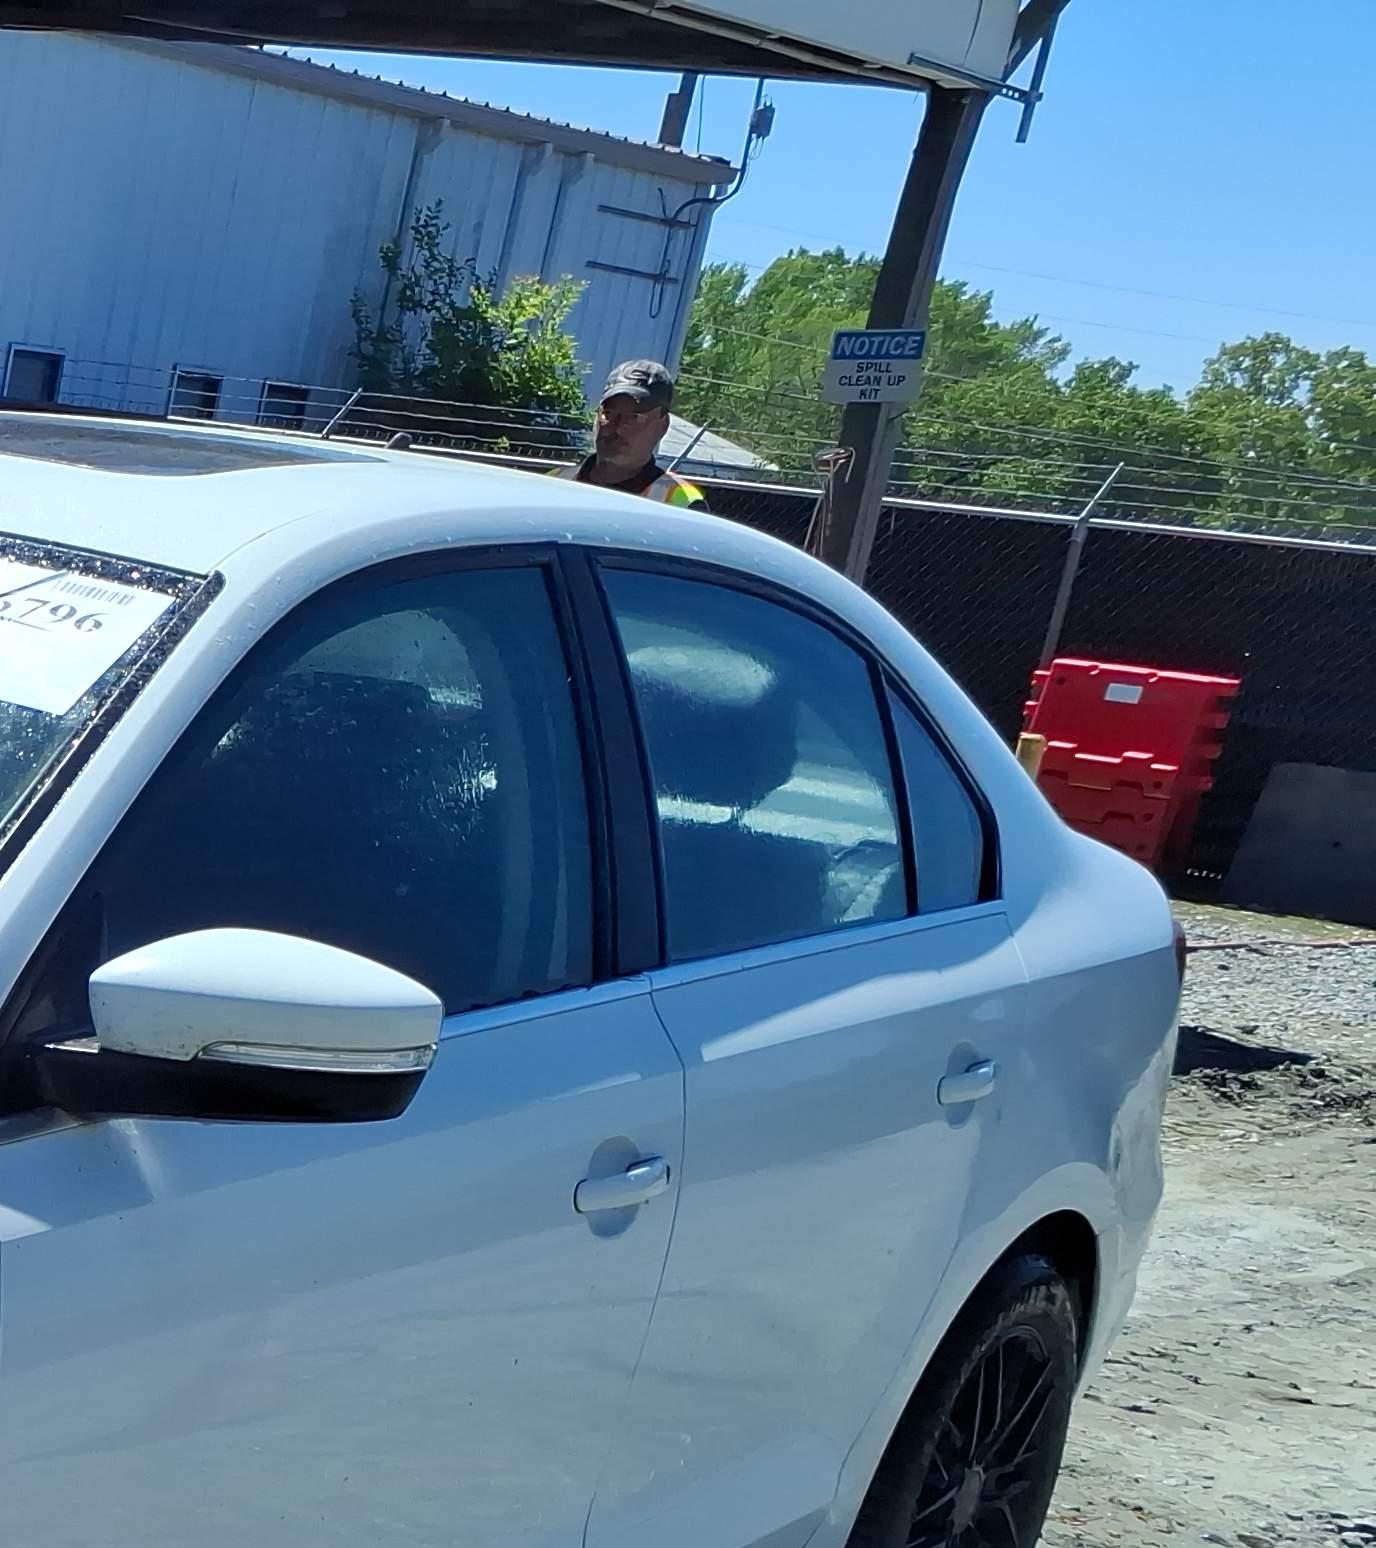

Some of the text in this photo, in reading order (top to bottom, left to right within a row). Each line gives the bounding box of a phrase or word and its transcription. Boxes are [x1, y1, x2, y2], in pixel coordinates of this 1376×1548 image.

[836, 335, 922, 356] NOTICE
[856, 362, 893, 373] SPILL
[838, 375, 906, 387] CLEAN UP
[859, 388, 880, 400] KIT
